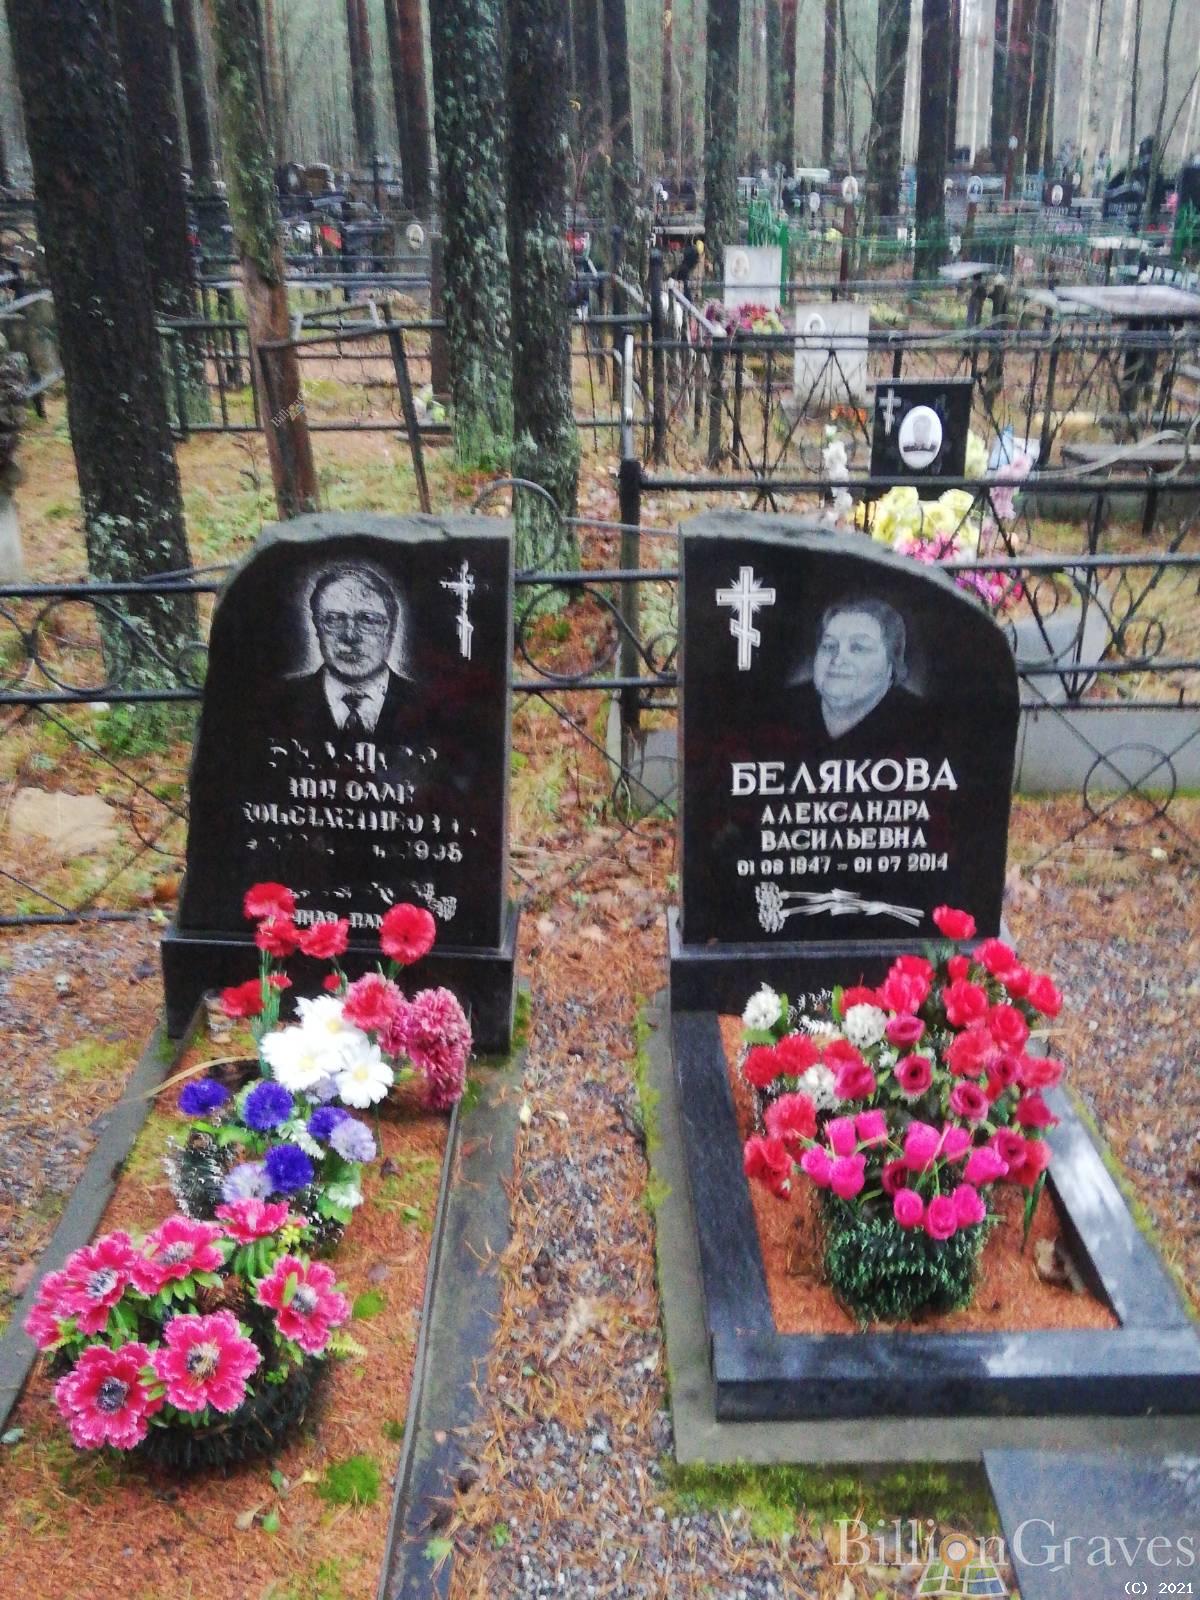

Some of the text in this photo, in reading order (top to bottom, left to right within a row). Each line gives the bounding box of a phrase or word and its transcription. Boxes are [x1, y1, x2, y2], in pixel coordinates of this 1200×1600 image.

[731, 757, 958, 796] БЕЛЯКОВА
[760, 799, 931, 825] АЛЕКСАНДРА
[760, 826, 928, 852] ВАСИЛЬЕВНА
[736, 860, 755, 876] 01
[853, 856, 872, 873] 01
[877, 855, 901, 873] 07
[907, 852, 948, 872] 2014
